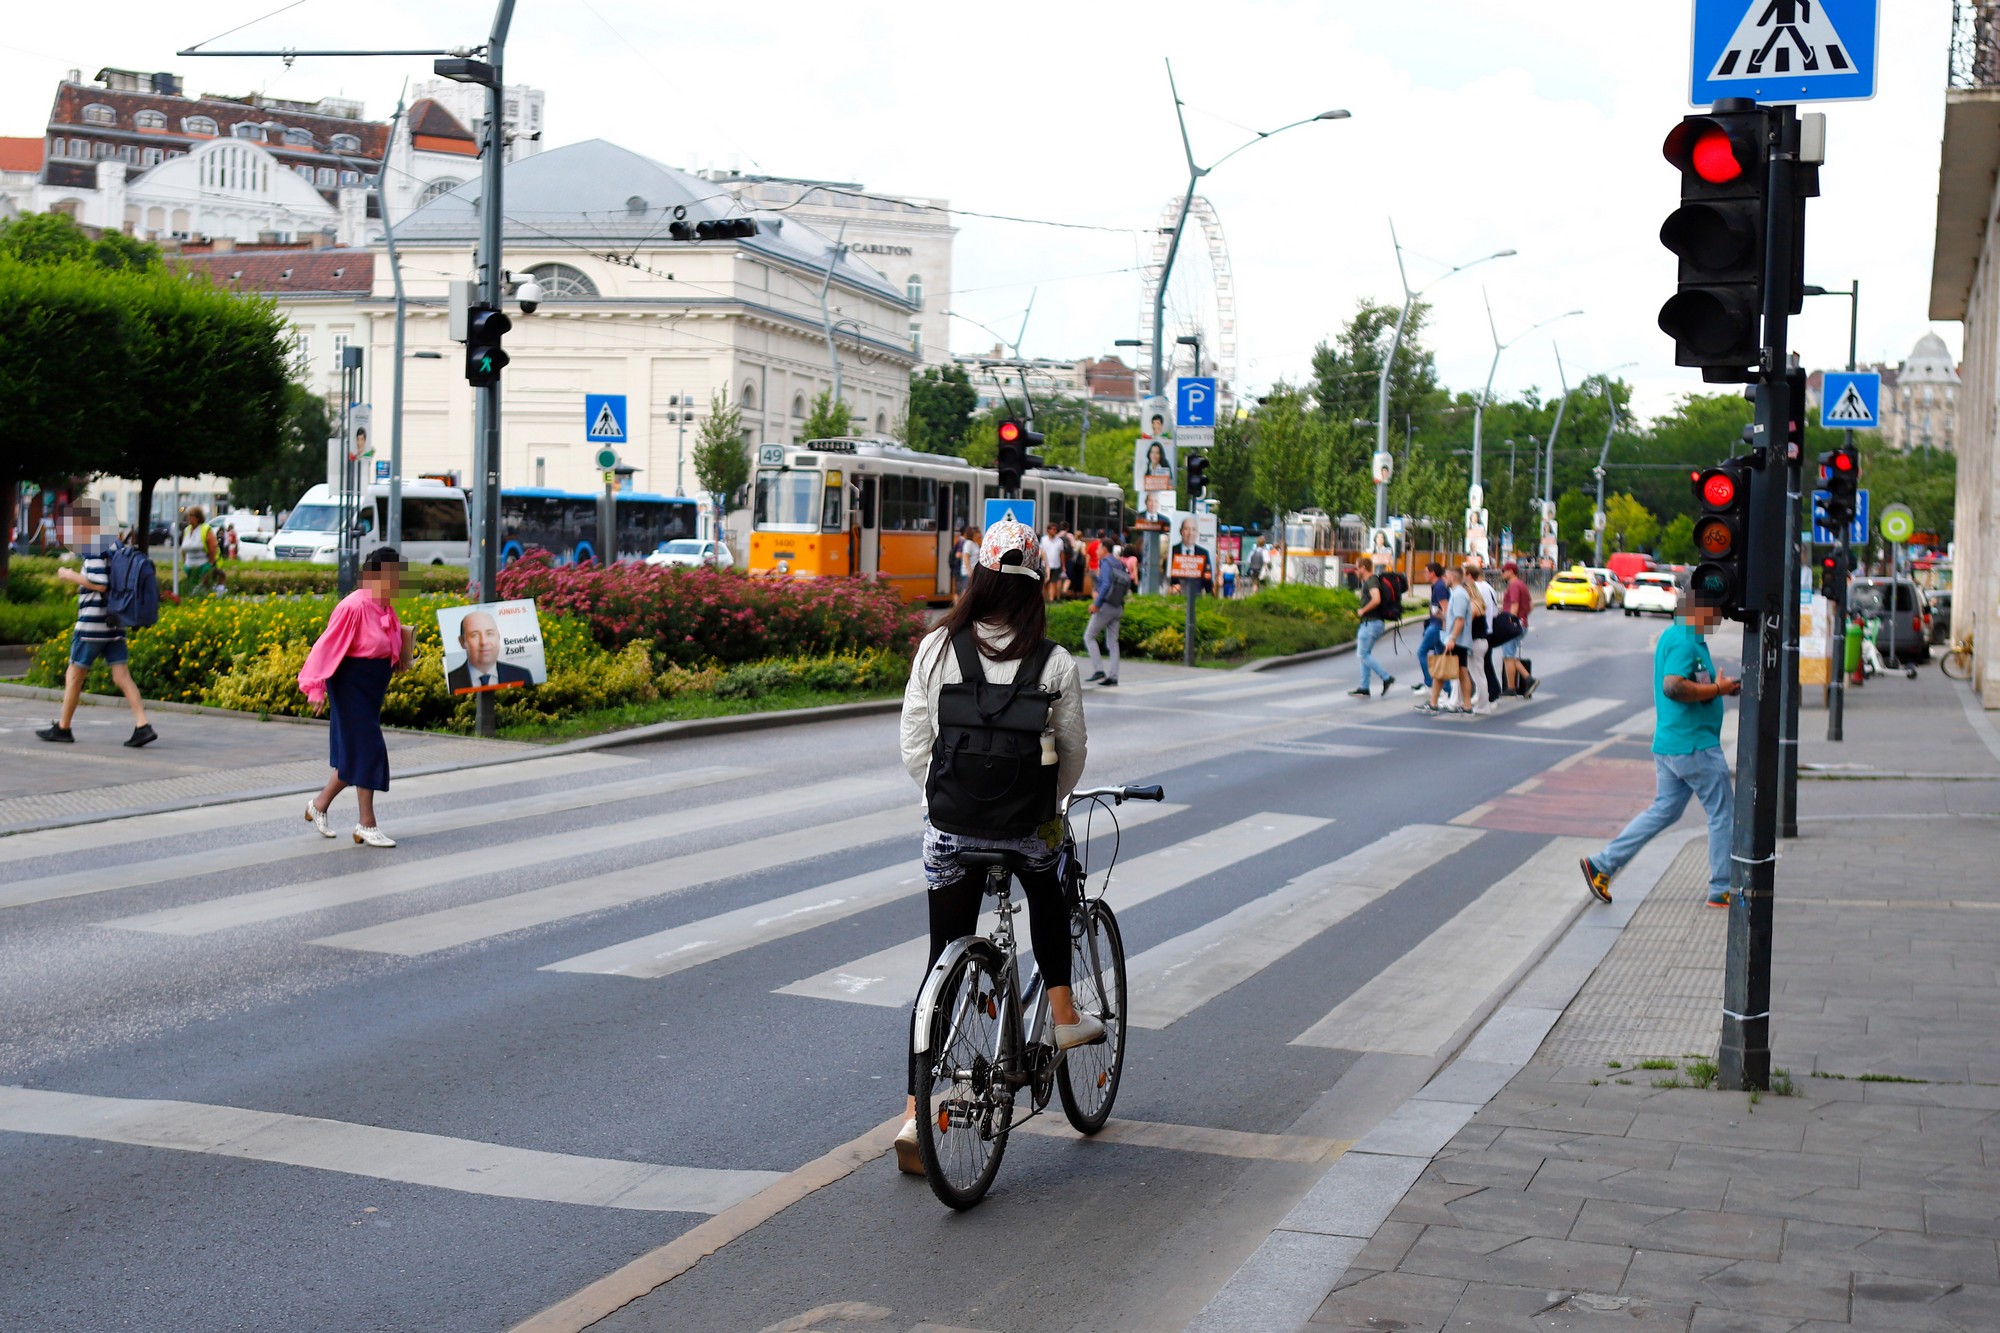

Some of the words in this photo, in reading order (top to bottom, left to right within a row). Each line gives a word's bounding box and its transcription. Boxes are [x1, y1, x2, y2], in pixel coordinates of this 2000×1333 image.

[852, 243, 912, 256] CARLTON
[1188, 389, 1205, 411] P
[763, 449, 782, 462] 49
[605, 471, 612, 481] E
[503, 634, 538, 646] Benedek
[505, 645, 525, 655] Zsolt
